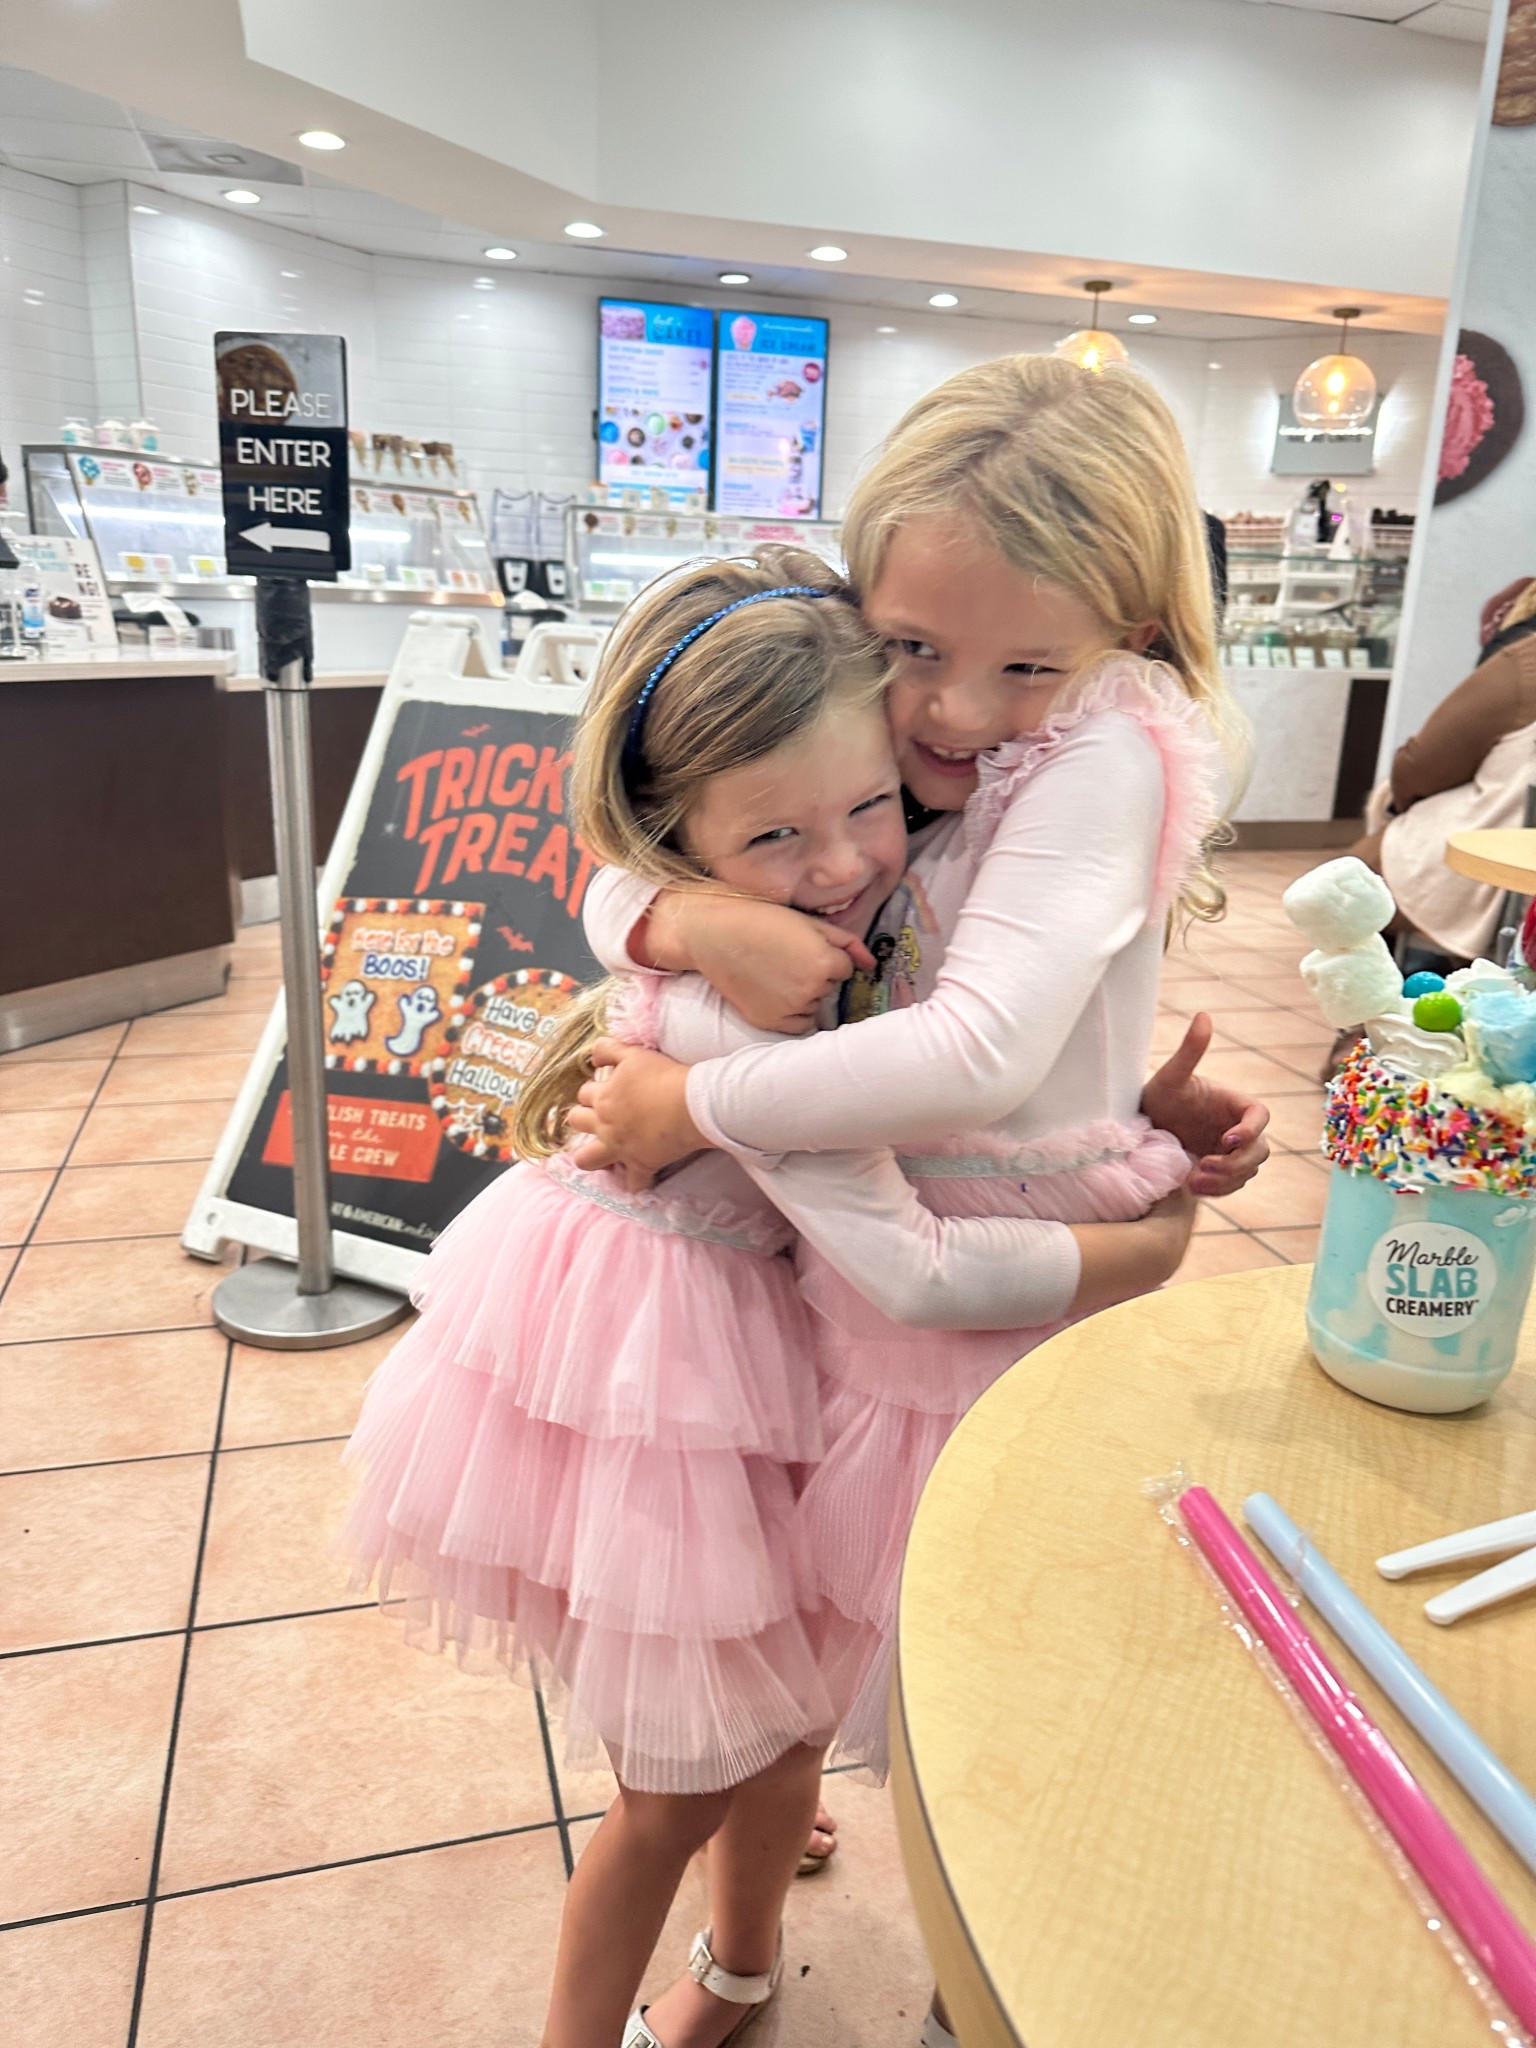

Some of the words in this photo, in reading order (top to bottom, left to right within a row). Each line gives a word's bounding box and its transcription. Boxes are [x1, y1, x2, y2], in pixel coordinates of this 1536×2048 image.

[231, 389, 332, 419] PLEASE
[237, 438, 331, 468] ENTER
[248, 486, 323, 515] HERE
[397, 743, 575, 840] TRICK
[414, 812, 606, 919] TREAT
[364, 954, 426, 979] BOOS!
[485, 998, 537, 1029] Have
[450, 1061, 520, 1099] Hallow
[371, 1108, 427, 1131] TREATS
[352, 1147, 399, 1167] CREW
[1386, 1239, 1479, 1267] Marble
[1385, 1263, 1478, 1299] SLAB
[1385, 1297, 1475, 1318] CREAMERY
